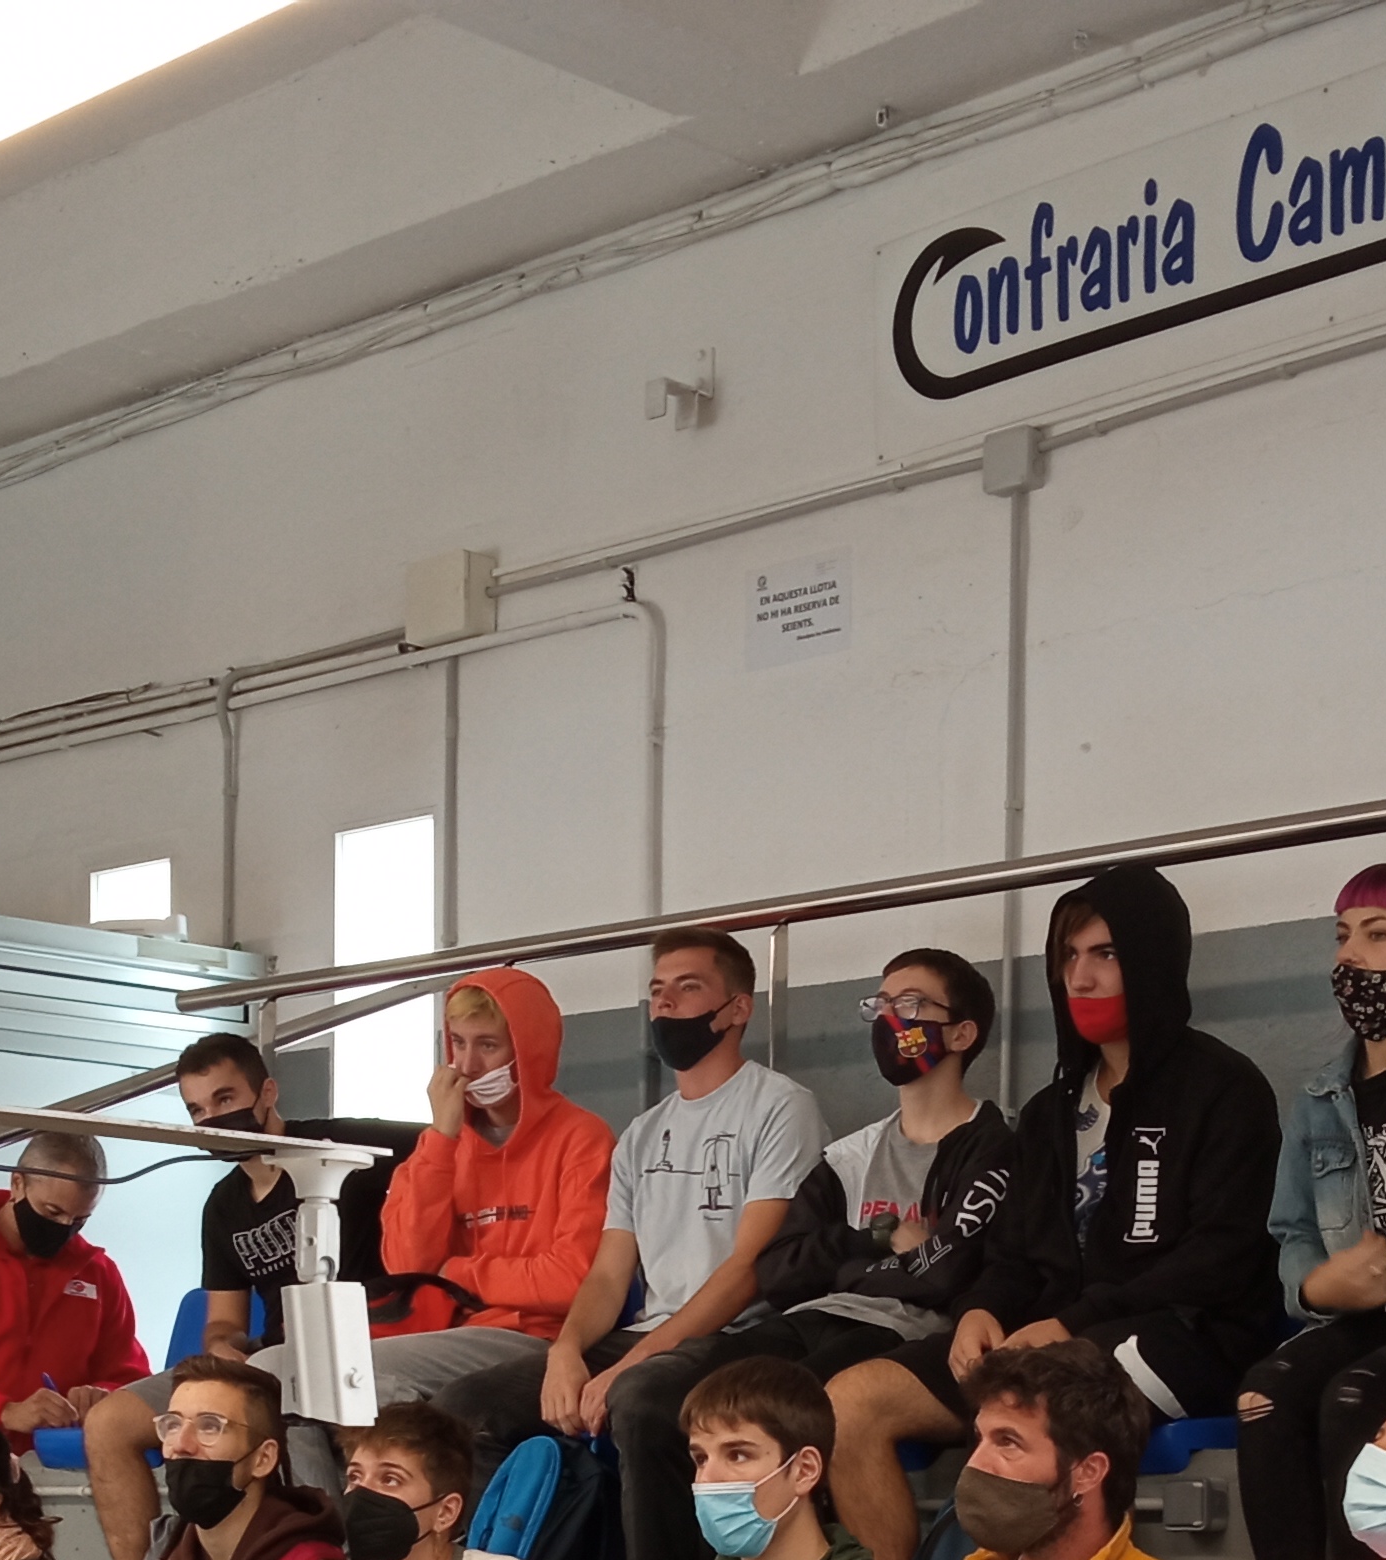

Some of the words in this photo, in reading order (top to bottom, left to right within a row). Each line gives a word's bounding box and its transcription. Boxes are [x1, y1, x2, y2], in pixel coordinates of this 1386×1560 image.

[893, 178, 1195, 398] Confraria
[756, 612, 769, 622] NO
[780, 606, 792, 617] HA
[793, 597, 827, 614] RESERVA
[829, 595, 840, 606] DE
[760, 596, 771, 606] EN
[772, 587, 808, 602] AQUESTA
[810, 580, 837, 594] LLOTJA
[1132, 1160, 1160, 1236] PUMA
